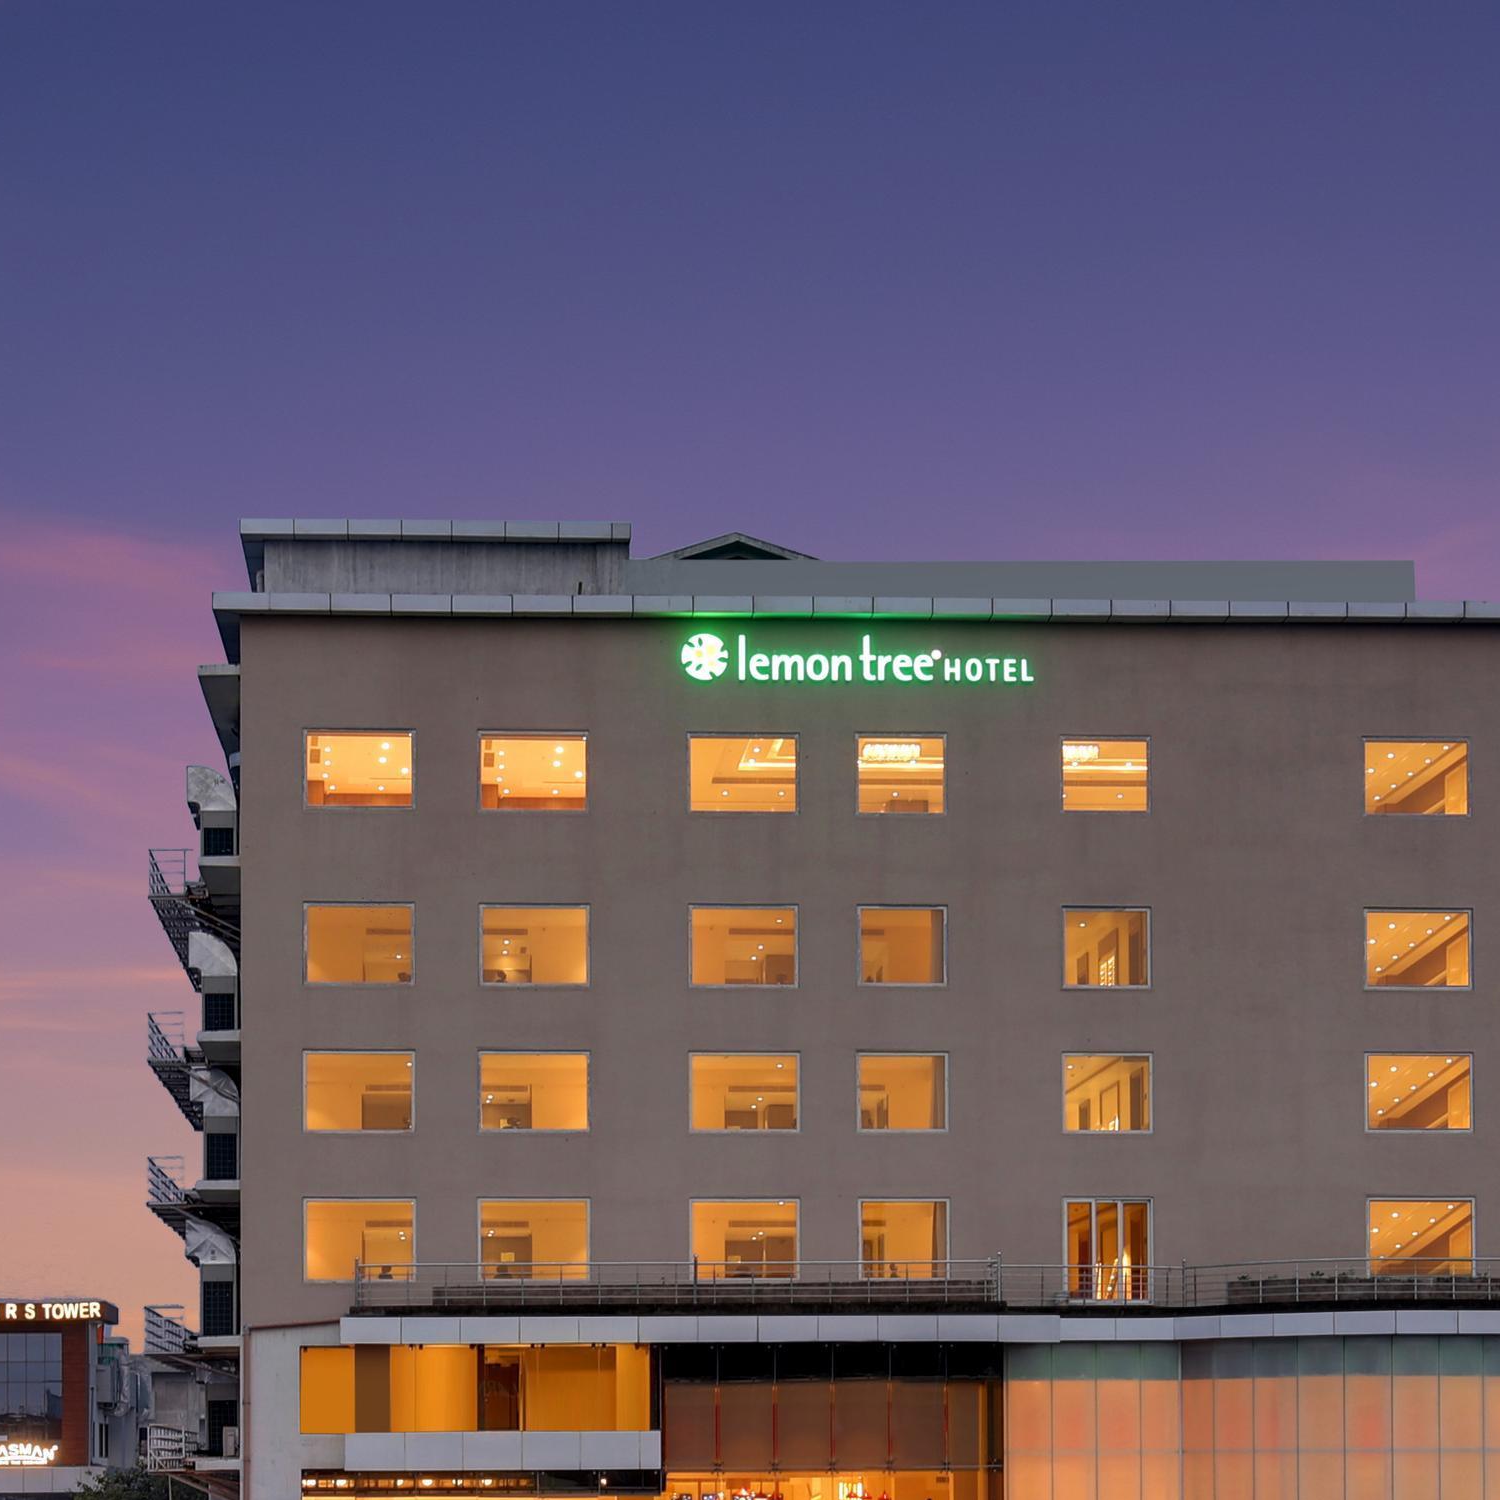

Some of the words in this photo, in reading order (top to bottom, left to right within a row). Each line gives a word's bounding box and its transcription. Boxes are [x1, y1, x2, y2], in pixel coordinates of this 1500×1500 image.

[739, 634, 852, 682] lemon
[859, 634, 937, 682] tree
[944, 658, 1035, 683] HOTEL
[6, 1303, 17, 1319] R
[25, 1303, 36, 1320] S
[42, 1302, 101, 1319] TOWER
